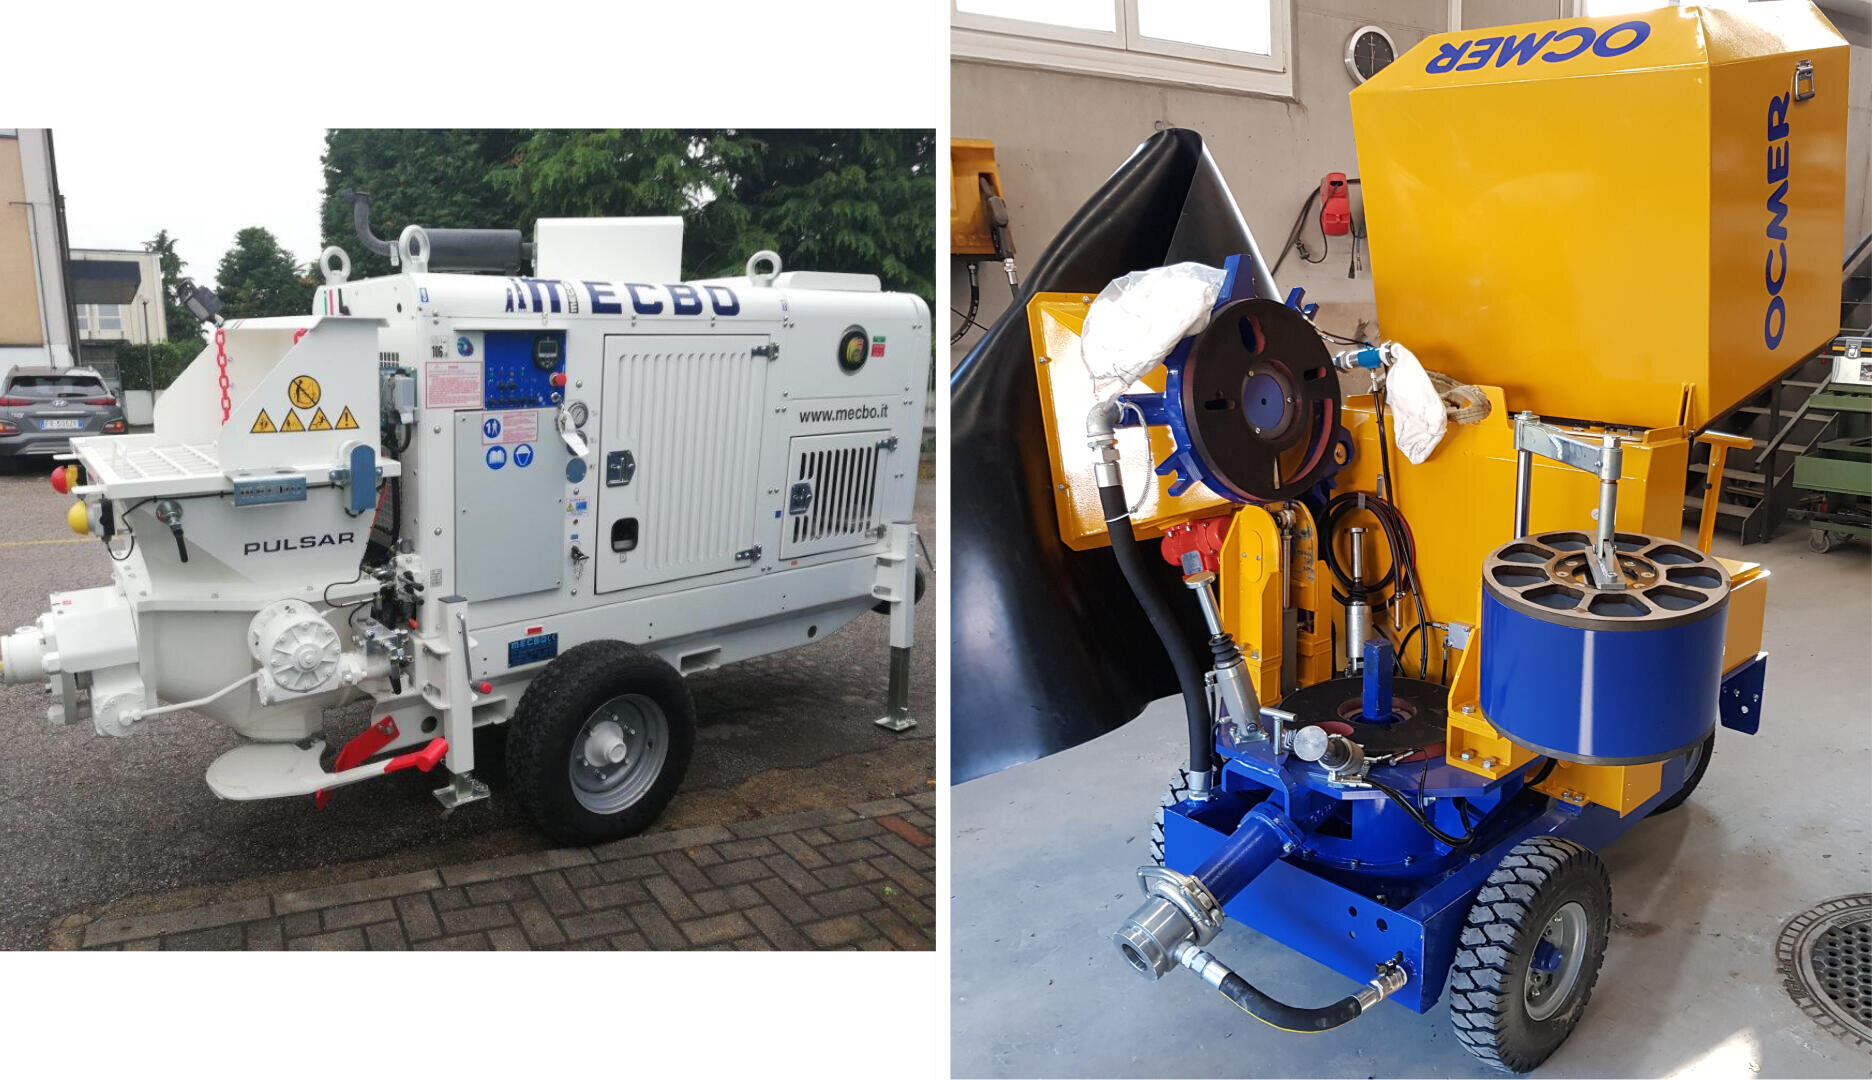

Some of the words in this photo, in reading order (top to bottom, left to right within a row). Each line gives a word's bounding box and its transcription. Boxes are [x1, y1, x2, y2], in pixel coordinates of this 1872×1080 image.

[1425, 20, 1651, 74] OCMER
[1765, 91, 1790, 350] OCMER
[799, 403, 889, 423] www.mecbo.it
[243, 532, 354, 555] PULSAR
